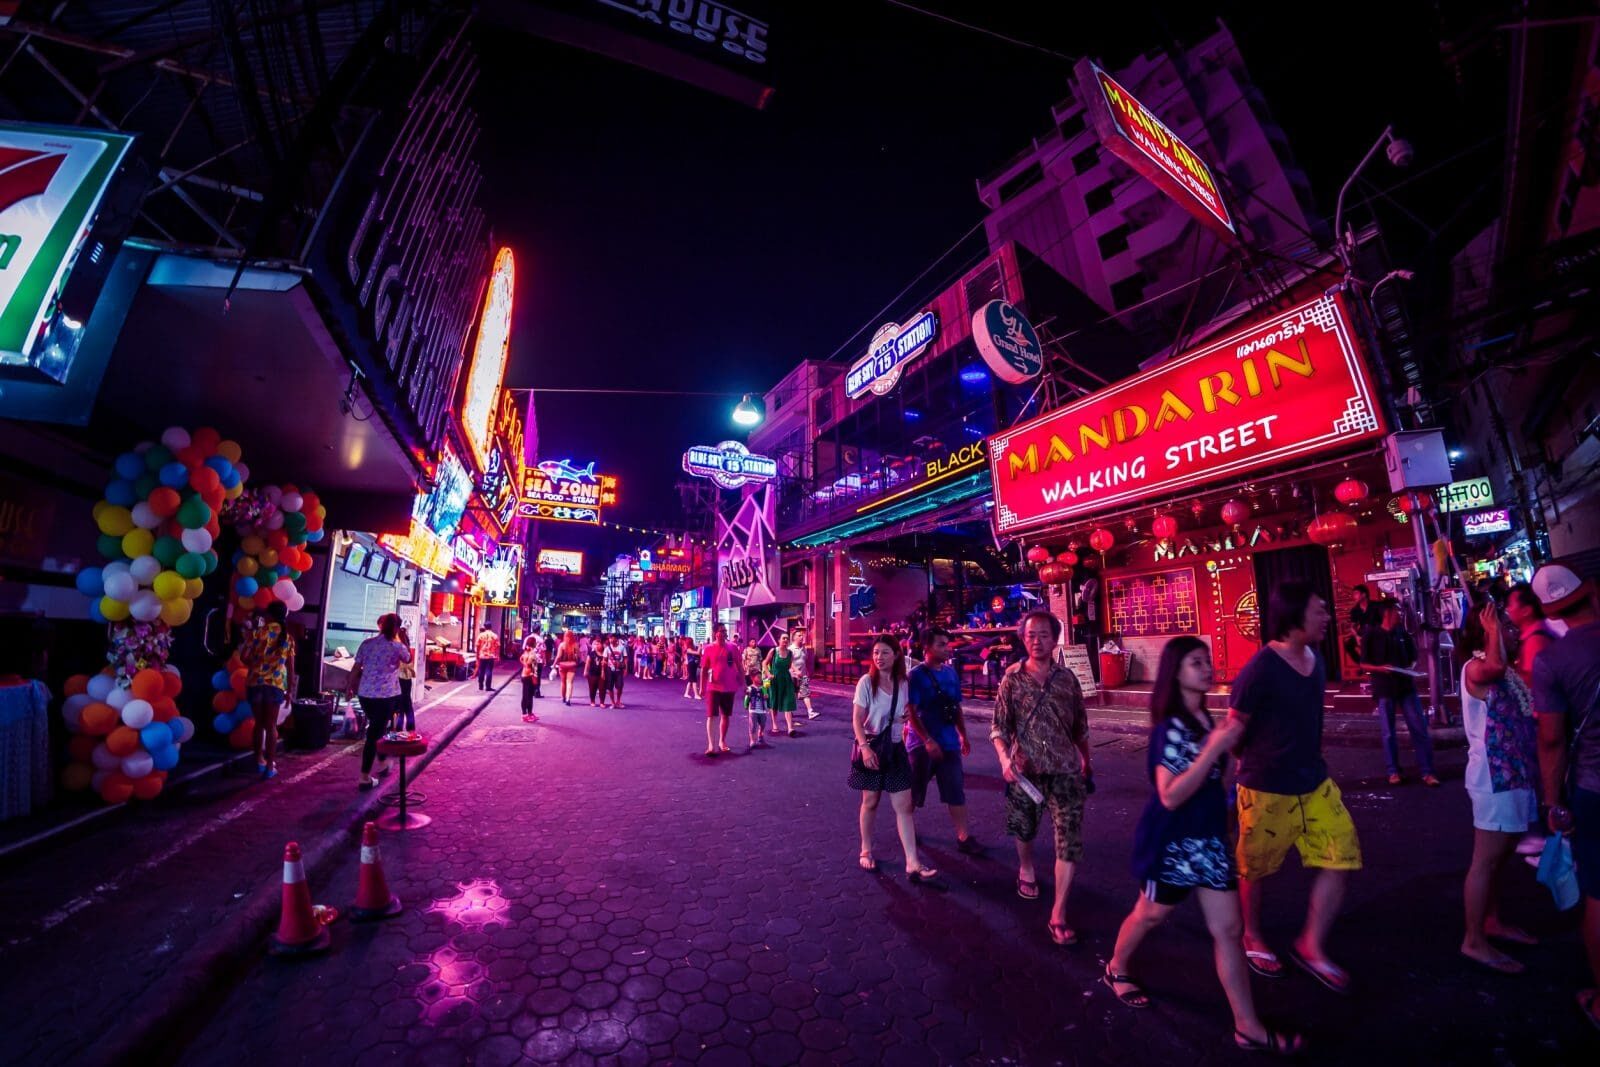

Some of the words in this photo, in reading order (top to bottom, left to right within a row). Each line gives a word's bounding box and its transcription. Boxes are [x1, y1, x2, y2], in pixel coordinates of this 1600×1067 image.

[1104, 81, 1215, 193] MANDARIN
[897, 317, 932, 357] STATION
[1236, 321, 1305, 358] แมนดาริน
[878, 351, 892, 374] 15
[1007, 338, 1317, 480] MANDARIN
[727, 460, 740, 472] 15
[744, 459, 776, 476] STATION
[926, 440, 984, 477] BLACK
[1042, 456, 1146, 504] WALKING
[1164, 415, 1278, 470] STREET
[524, 478, 553, 494] SEA
[558, 481, 600, 499] ZONE
[526, 490, 542, 500] SEA
[543, 493, 565, 502] FOOD
[1465, 510, 1505, 525] ANN'S
[721, 558, 755, 590] BLISS
